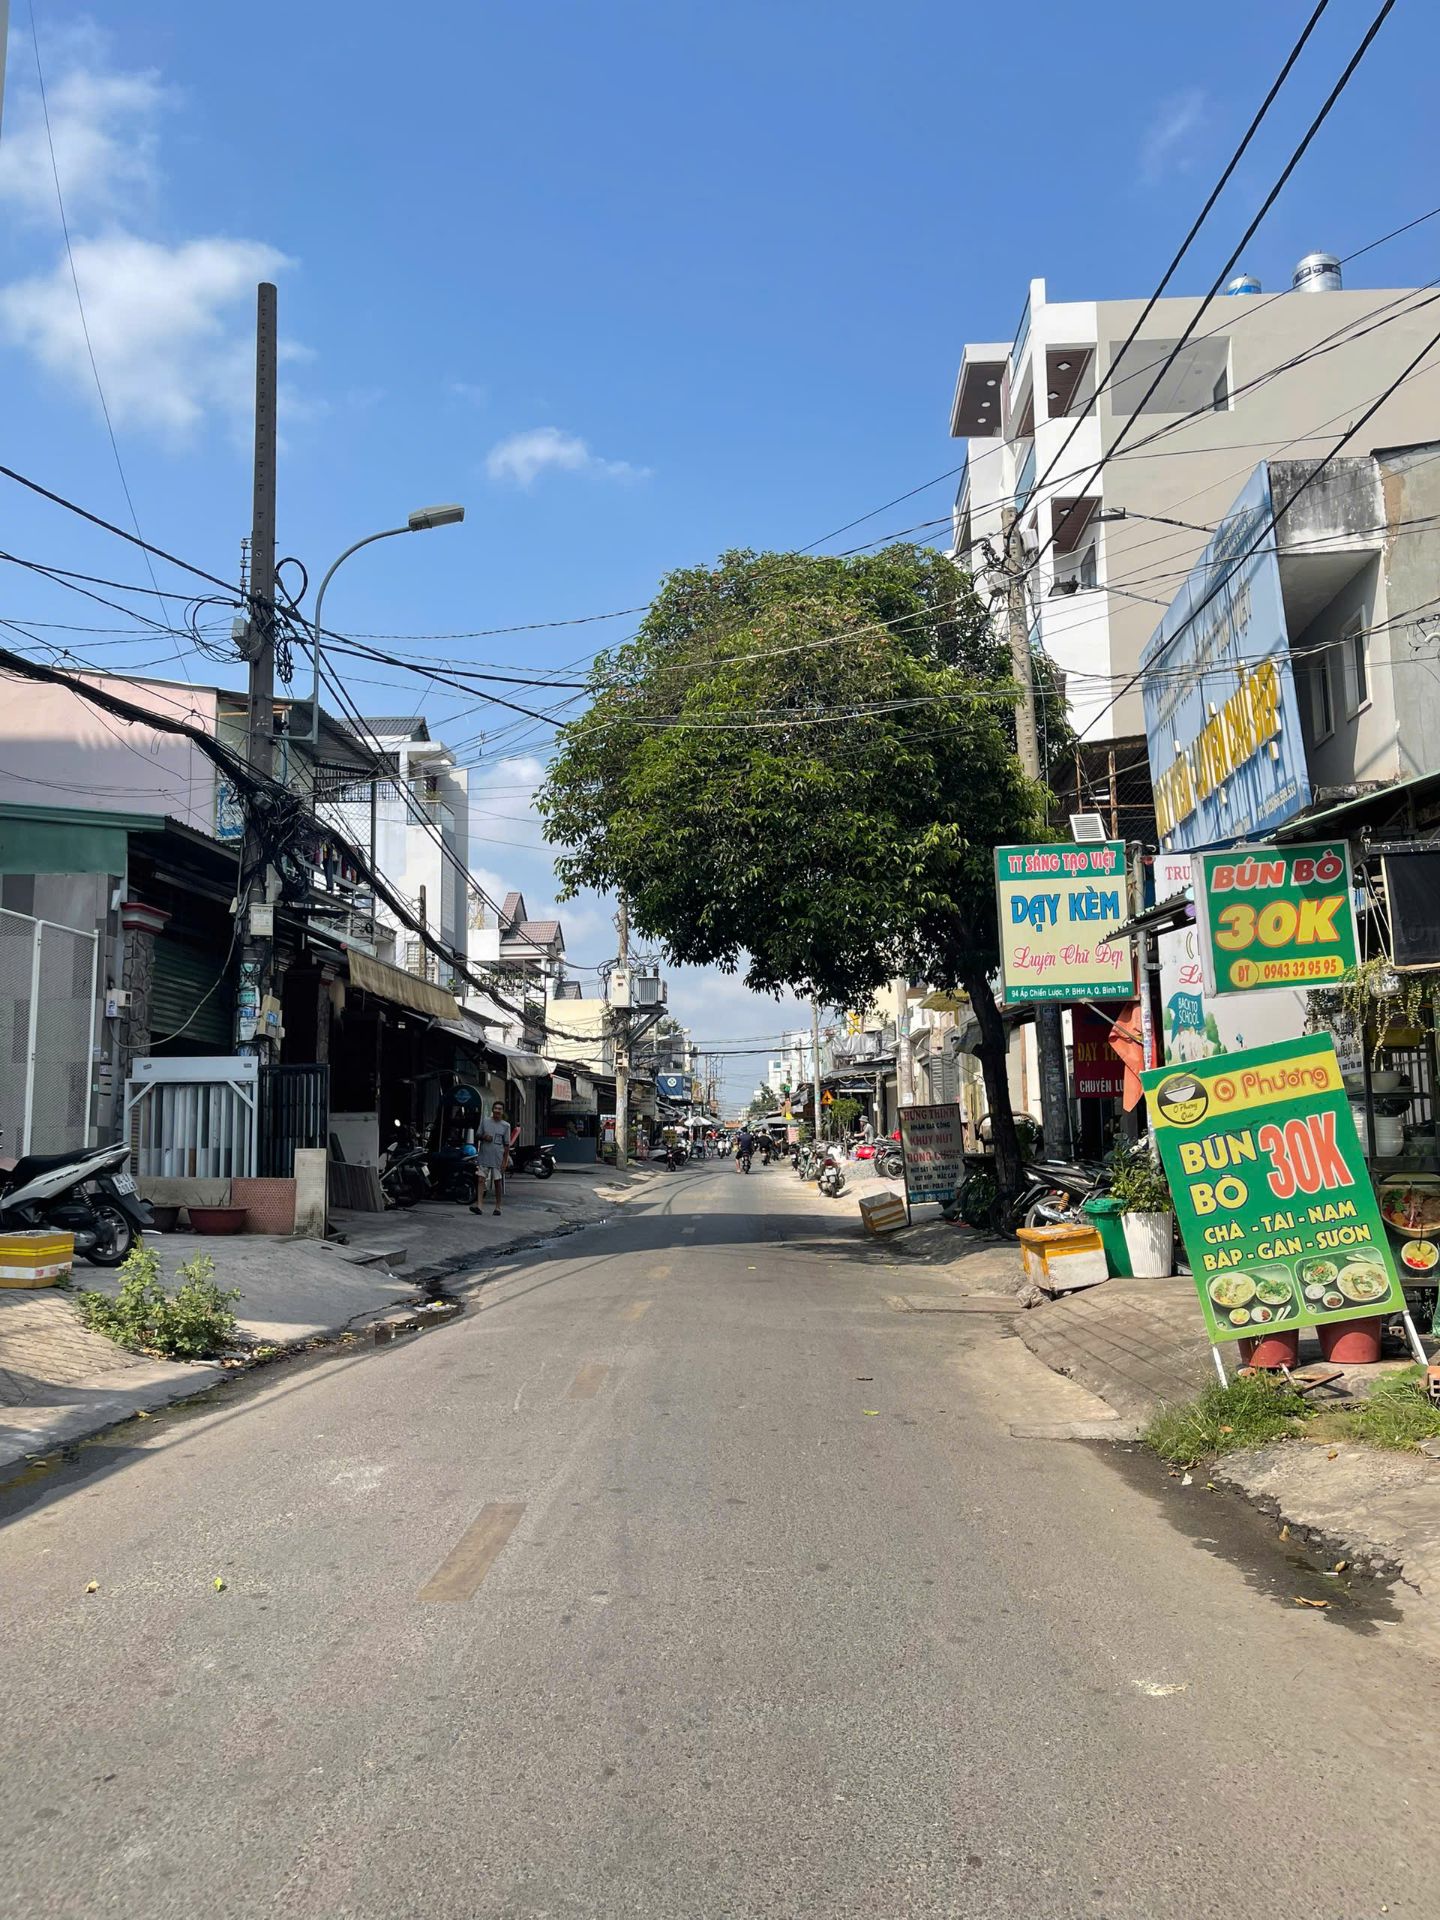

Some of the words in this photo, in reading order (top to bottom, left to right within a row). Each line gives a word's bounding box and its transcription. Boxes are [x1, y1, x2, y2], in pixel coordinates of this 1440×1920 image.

[1008, 855, 1022, 873] TT
[1025, 849, 1060, 873] SÁNG
[1062, 852, 1088, 876] TẠO
[1090, 846, 1116, 875] VIỆT
[1165, 866, 1191, 880] TRU
[1211, 856, 1287, 892] BÚN
[1290, 849, 1343, 886] BÒ
[1010, 894, 1061, 932] DẠY
[1068, 885, 1120, 921] KÈM
[1215, 896, 1345, 951] 30K
[1012, 946, 1056, 976] Luyện
[1059, 944, 1089, 965] Chữ
[1095, 944, 1124, 969] Đẹp
[1264, 963, 1290, 979] 0943
[1292, 961, 1305, 977] 32
[1308, 960, 1321, 975] 95
[1323, 958, 1337, 974] 95
[1178, 997, 1189, 1010] BACK
[1189, 1001, 1198, 1012] TO
[1179, 1010, 1200, 1024] SCHOOL
[1242, 1065, 1329, 1100] Phương
[909, 1135, 933, 1146] KHUY
[1178, 1129, 1259, 1175] BÚN
[1257, 1111, 1355, 1199] 30K
[1188, 1173, 1248, 1216] BÒ
[1203, 1219, 1246, 1244] CHẢ
[1307, 1199, 1358, 1224] NẠM
